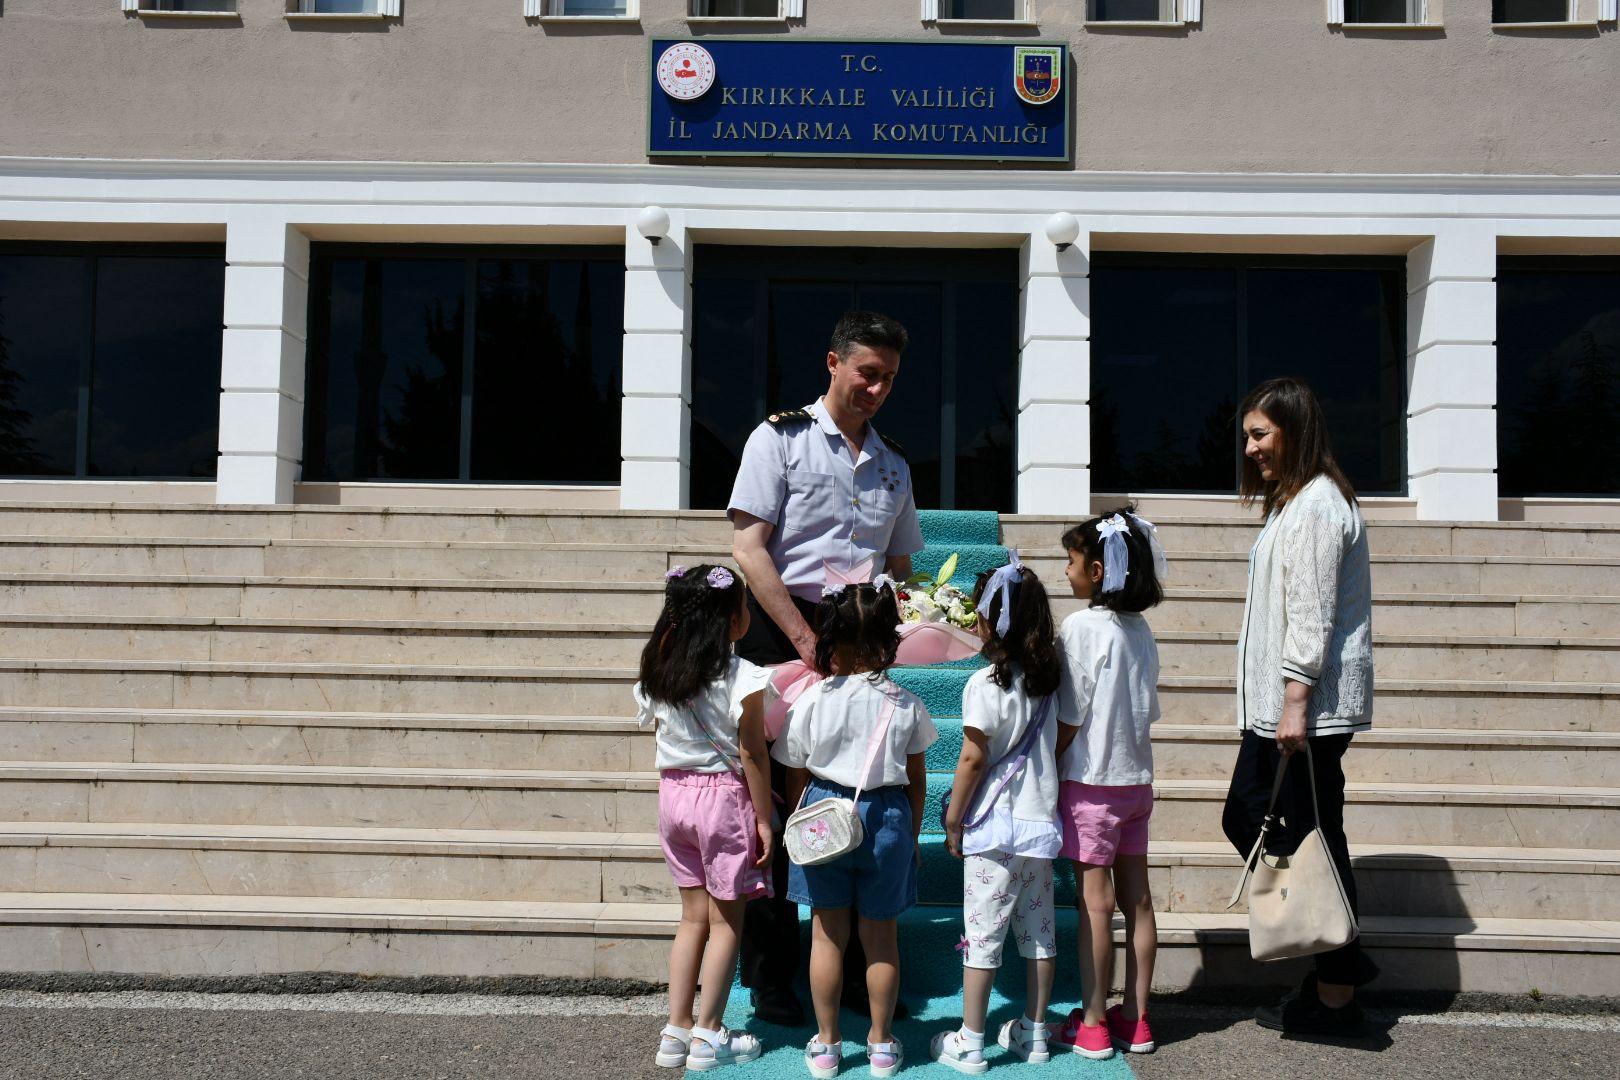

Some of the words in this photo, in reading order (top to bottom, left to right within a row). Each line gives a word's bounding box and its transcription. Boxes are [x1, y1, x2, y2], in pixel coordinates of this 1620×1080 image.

[841, 54, 883, 72] T.C.
[721, 86, 866, 106] KIRIKKALE
[892, 85, 995, 108] VALİLİĞİ
[668, 117, 692, 139] İL
[712, 122, 852, 141] JANDARMA
[873, 123, 1048, 144] KOMUTANLIĞI
